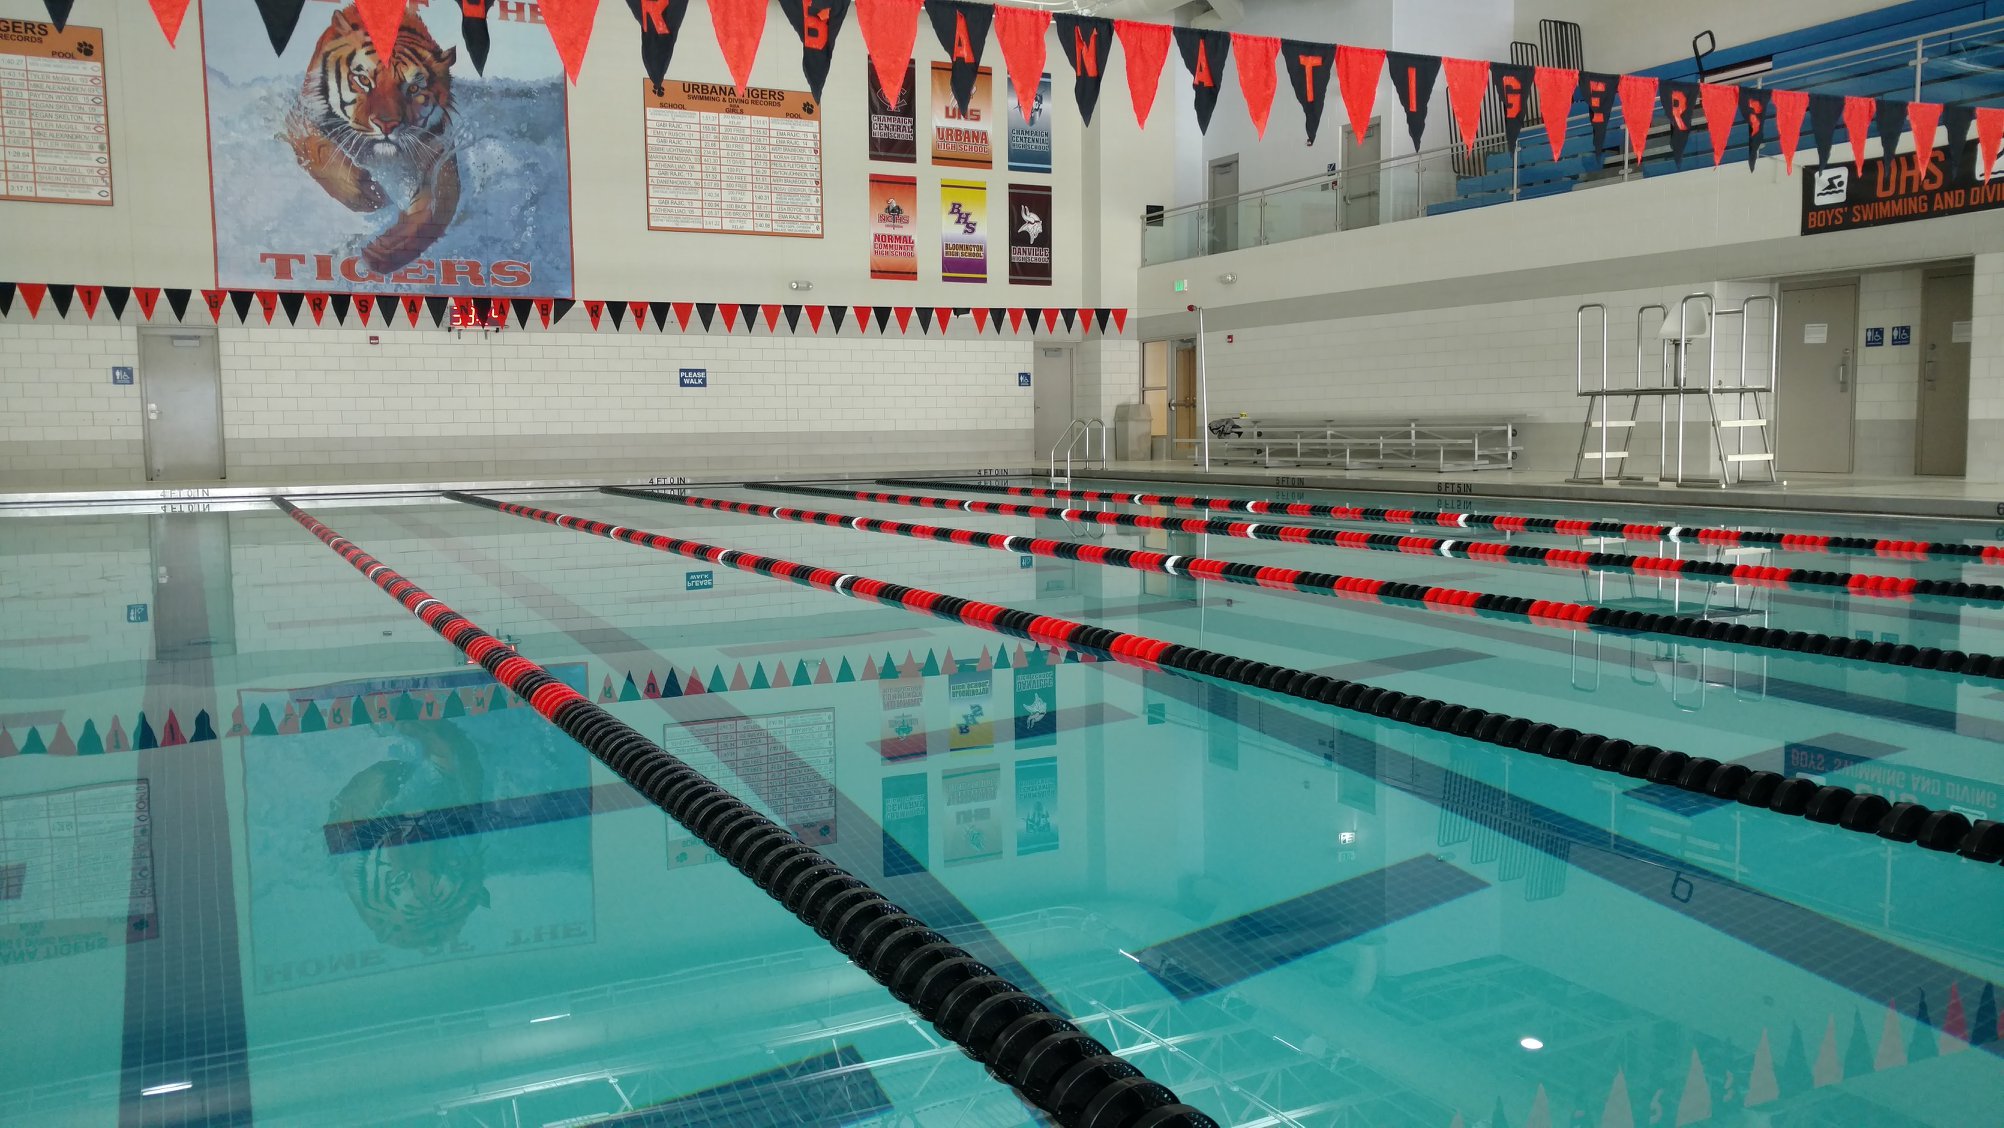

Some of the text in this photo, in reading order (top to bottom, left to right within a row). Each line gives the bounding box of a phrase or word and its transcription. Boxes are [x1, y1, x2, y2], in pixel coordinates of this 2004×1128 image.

[0, 33, 43, 44] RECORDS
[51, 51, 75, 59] POOL
[681, 82, 737, 97] URBANA
[686, 94, 721, 102] SWIMMING
[727, 97, 750, 105] DIVING
[749, 99, 781, 107] RECORDS
[659, 102, 687, 110] SCHOOL
[872, 115, 913, 124] CHAMPAIGN
[872, 122, 913, 134] CENTRAL
[889, 132, 913, 140] SCHOOL
[936, 127, 989, 144] URBANA
[1011, 129, 1049, 138] CHAMPAIGN
[1011, 136, 1049, 145] CENTENNIAL
[937, 142, 989, 154] HIGH SCHOOL
[1028, 143, 1050, 151] SCHOOL
[1876, 151, 1946, 198] UHS
[1808, 207, 1848, 229] BOYS'
[1852, 195, 1928, 222] SWIMMING
[1933, 189, 1964, 211] AND
[874, 233, 914, 245] NORMAL
[874, 243, 915, 252] COMMUNITY
[944, 243, 984, 252] BLOOMINGTON
[1012, 247, 1049, 257] DANVILLE
[890, 250, 914, 258] SCHOOL
[1026, 256, 1050, 264] SCHOOL
[260, 252, 533, 288] TIGERS
[1437, 482, 1443, 492] 6
[1445, 483, 1456, 492] FT
[1464, 483, 1472, 493] IN
